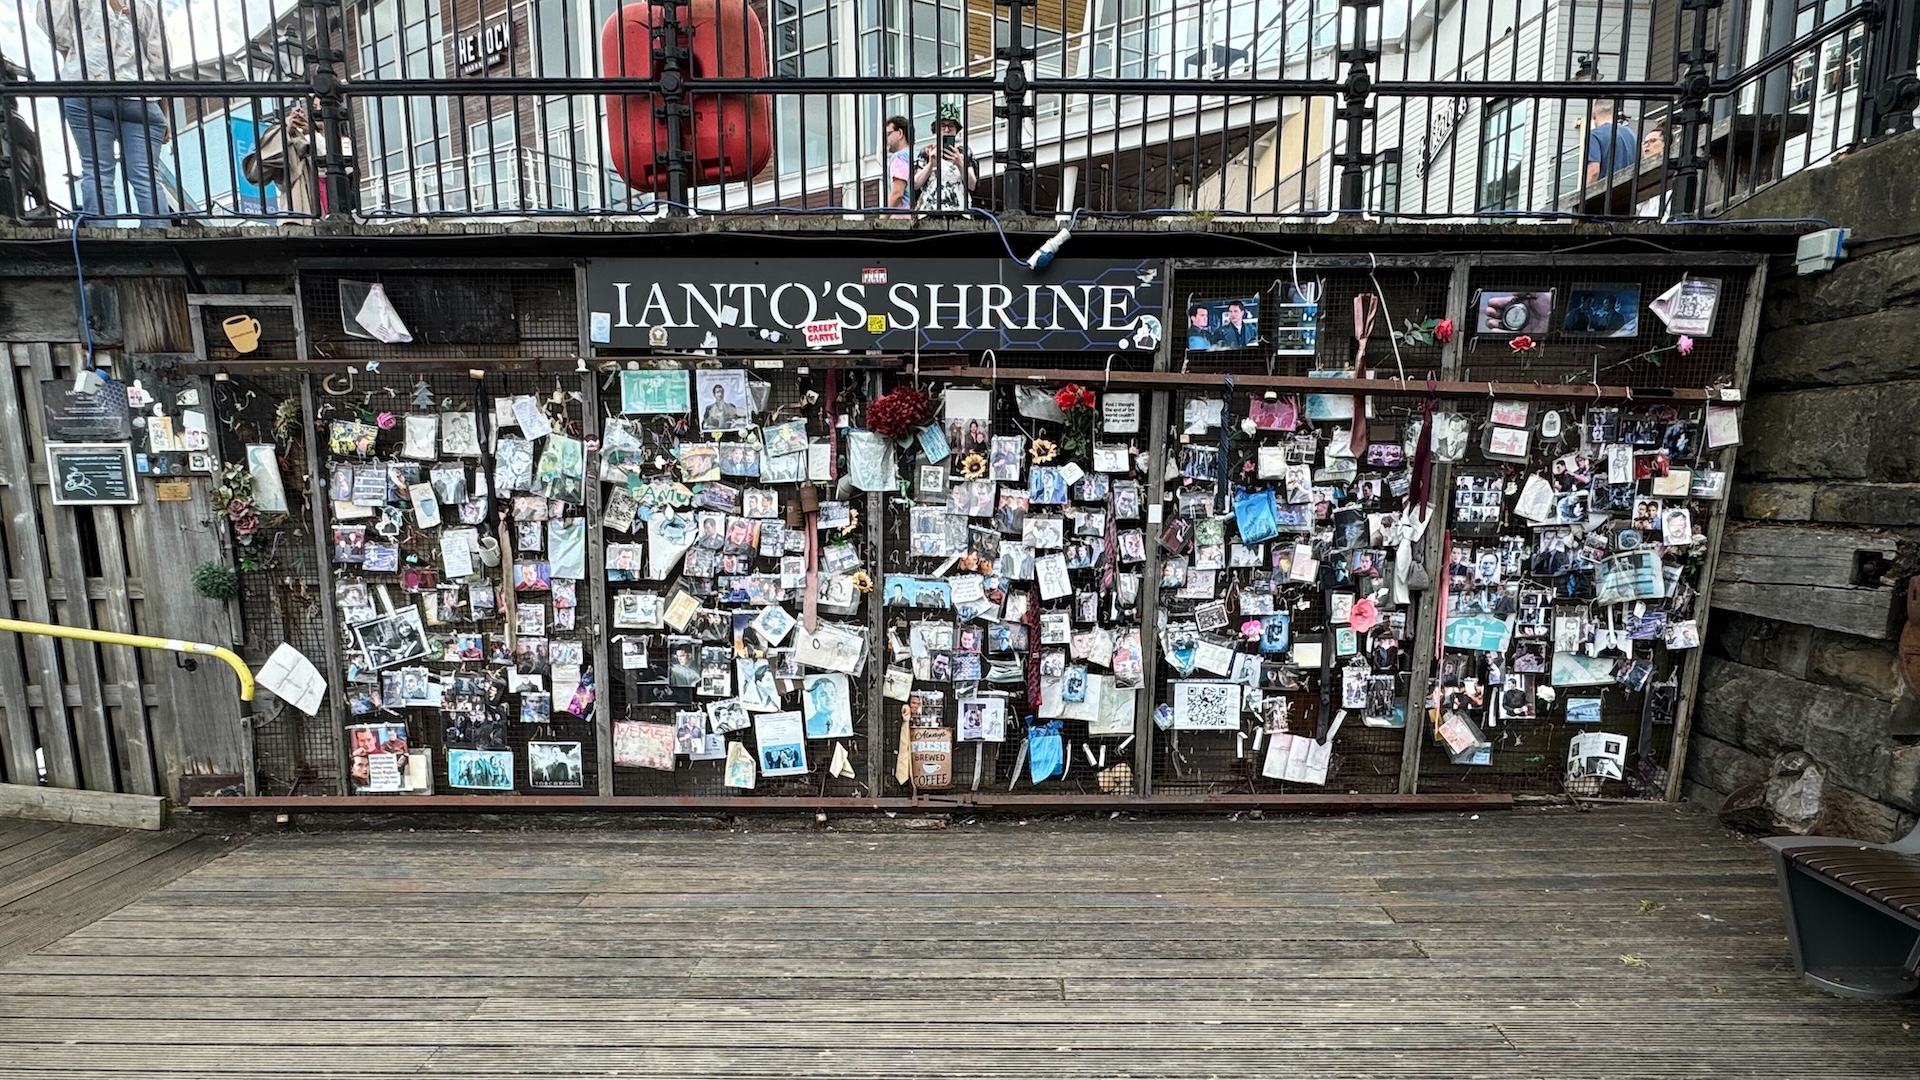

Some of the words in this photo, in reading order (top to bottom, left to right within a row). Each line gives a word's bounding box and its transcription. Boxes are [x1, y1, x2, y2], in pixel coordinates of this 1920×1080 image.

[452, 36, 475, 65] HE
[613, 281, 867, 330] IANTO'S
[887, 283, 1139, 331] SHRINE
[806, 322, 839, 333] CREEPY
[807, 333, 840, 343] CARTEL
[914, 731, 947, 741] Always
[914, 754, 946, 762] BREWED
[913, 774, 948, 787] COFFEE
